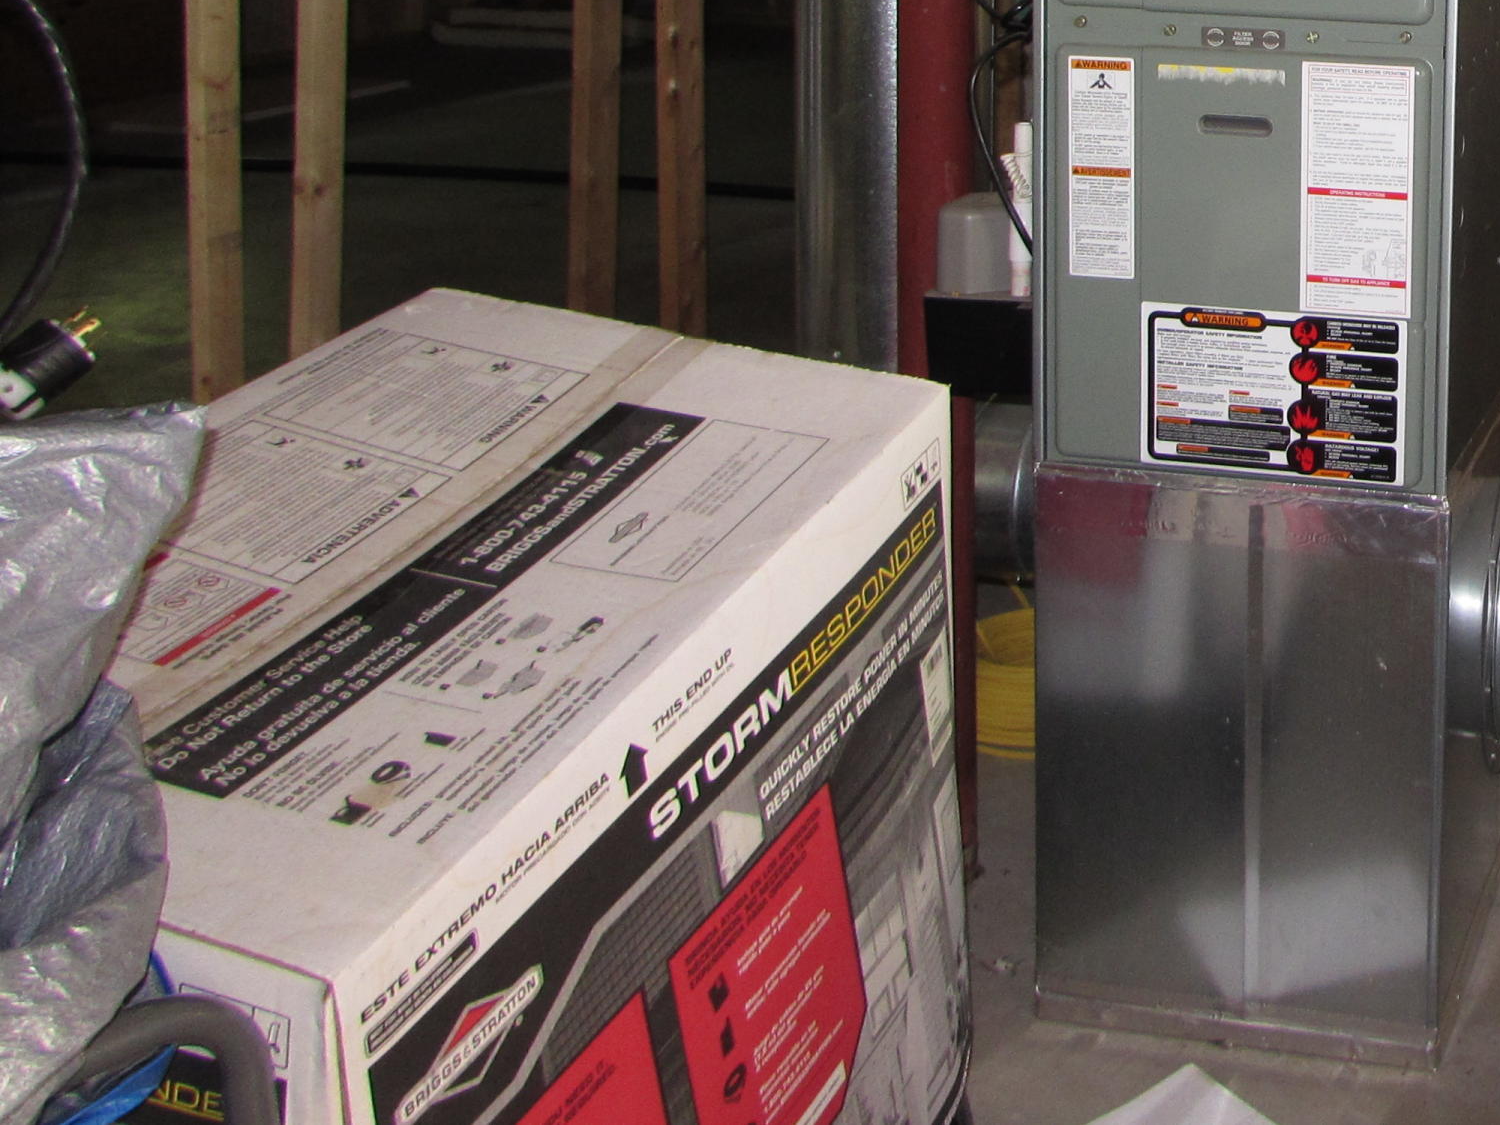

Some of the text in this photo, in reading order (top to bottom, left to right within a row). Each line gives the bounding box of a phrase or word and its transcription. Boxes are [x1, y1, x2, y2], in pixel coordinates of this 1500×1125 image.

[1082, 60, 1127, 70] WARNING
[1201, 314, 1249, 326] WARNING
[478, 404, 536, 444] WARNING
[302, 497, 403, 565] ADVERTENCIA
[459, 470, 588, 566] 1-800-743-4115
[478, 423, 685, 574] BRIGGSandSTRATTON.com
[157, 622, 375, 770] Do Not Return to the Store
[178, 675, 270, 739] Customer
[263, 636, 328, 680] Service
[320, 613, 367, 642] Help
[194, 735, 259, 783] Ayuda
[253, 690, 325, 743] gratuita
[315, 675, 347, 695] de
[340, 633, 405, 679] servicio
[396, 622, 420, 636] al
[412, 586, 468, 624] cliente
[212, 637, 422, 789] No lo devuelva a la tienda.
[651, 647, 733, 733] THIS END UP
[758, 567, 943, 802] QUICKLY RESTORE POWER IN MINUTES
[764, 724, 839, 821] RESTABLECE
[838, 706, 855, 737] LA
[853, 652, 897, 718] ENERGÍA
[895, 631, 911, 665] EN
[360, 769, 609, 1027] ESTE EXTREMO HACIA ARRIBA
[401, 974, 537, 1117] BRIGGS & STRATTON
